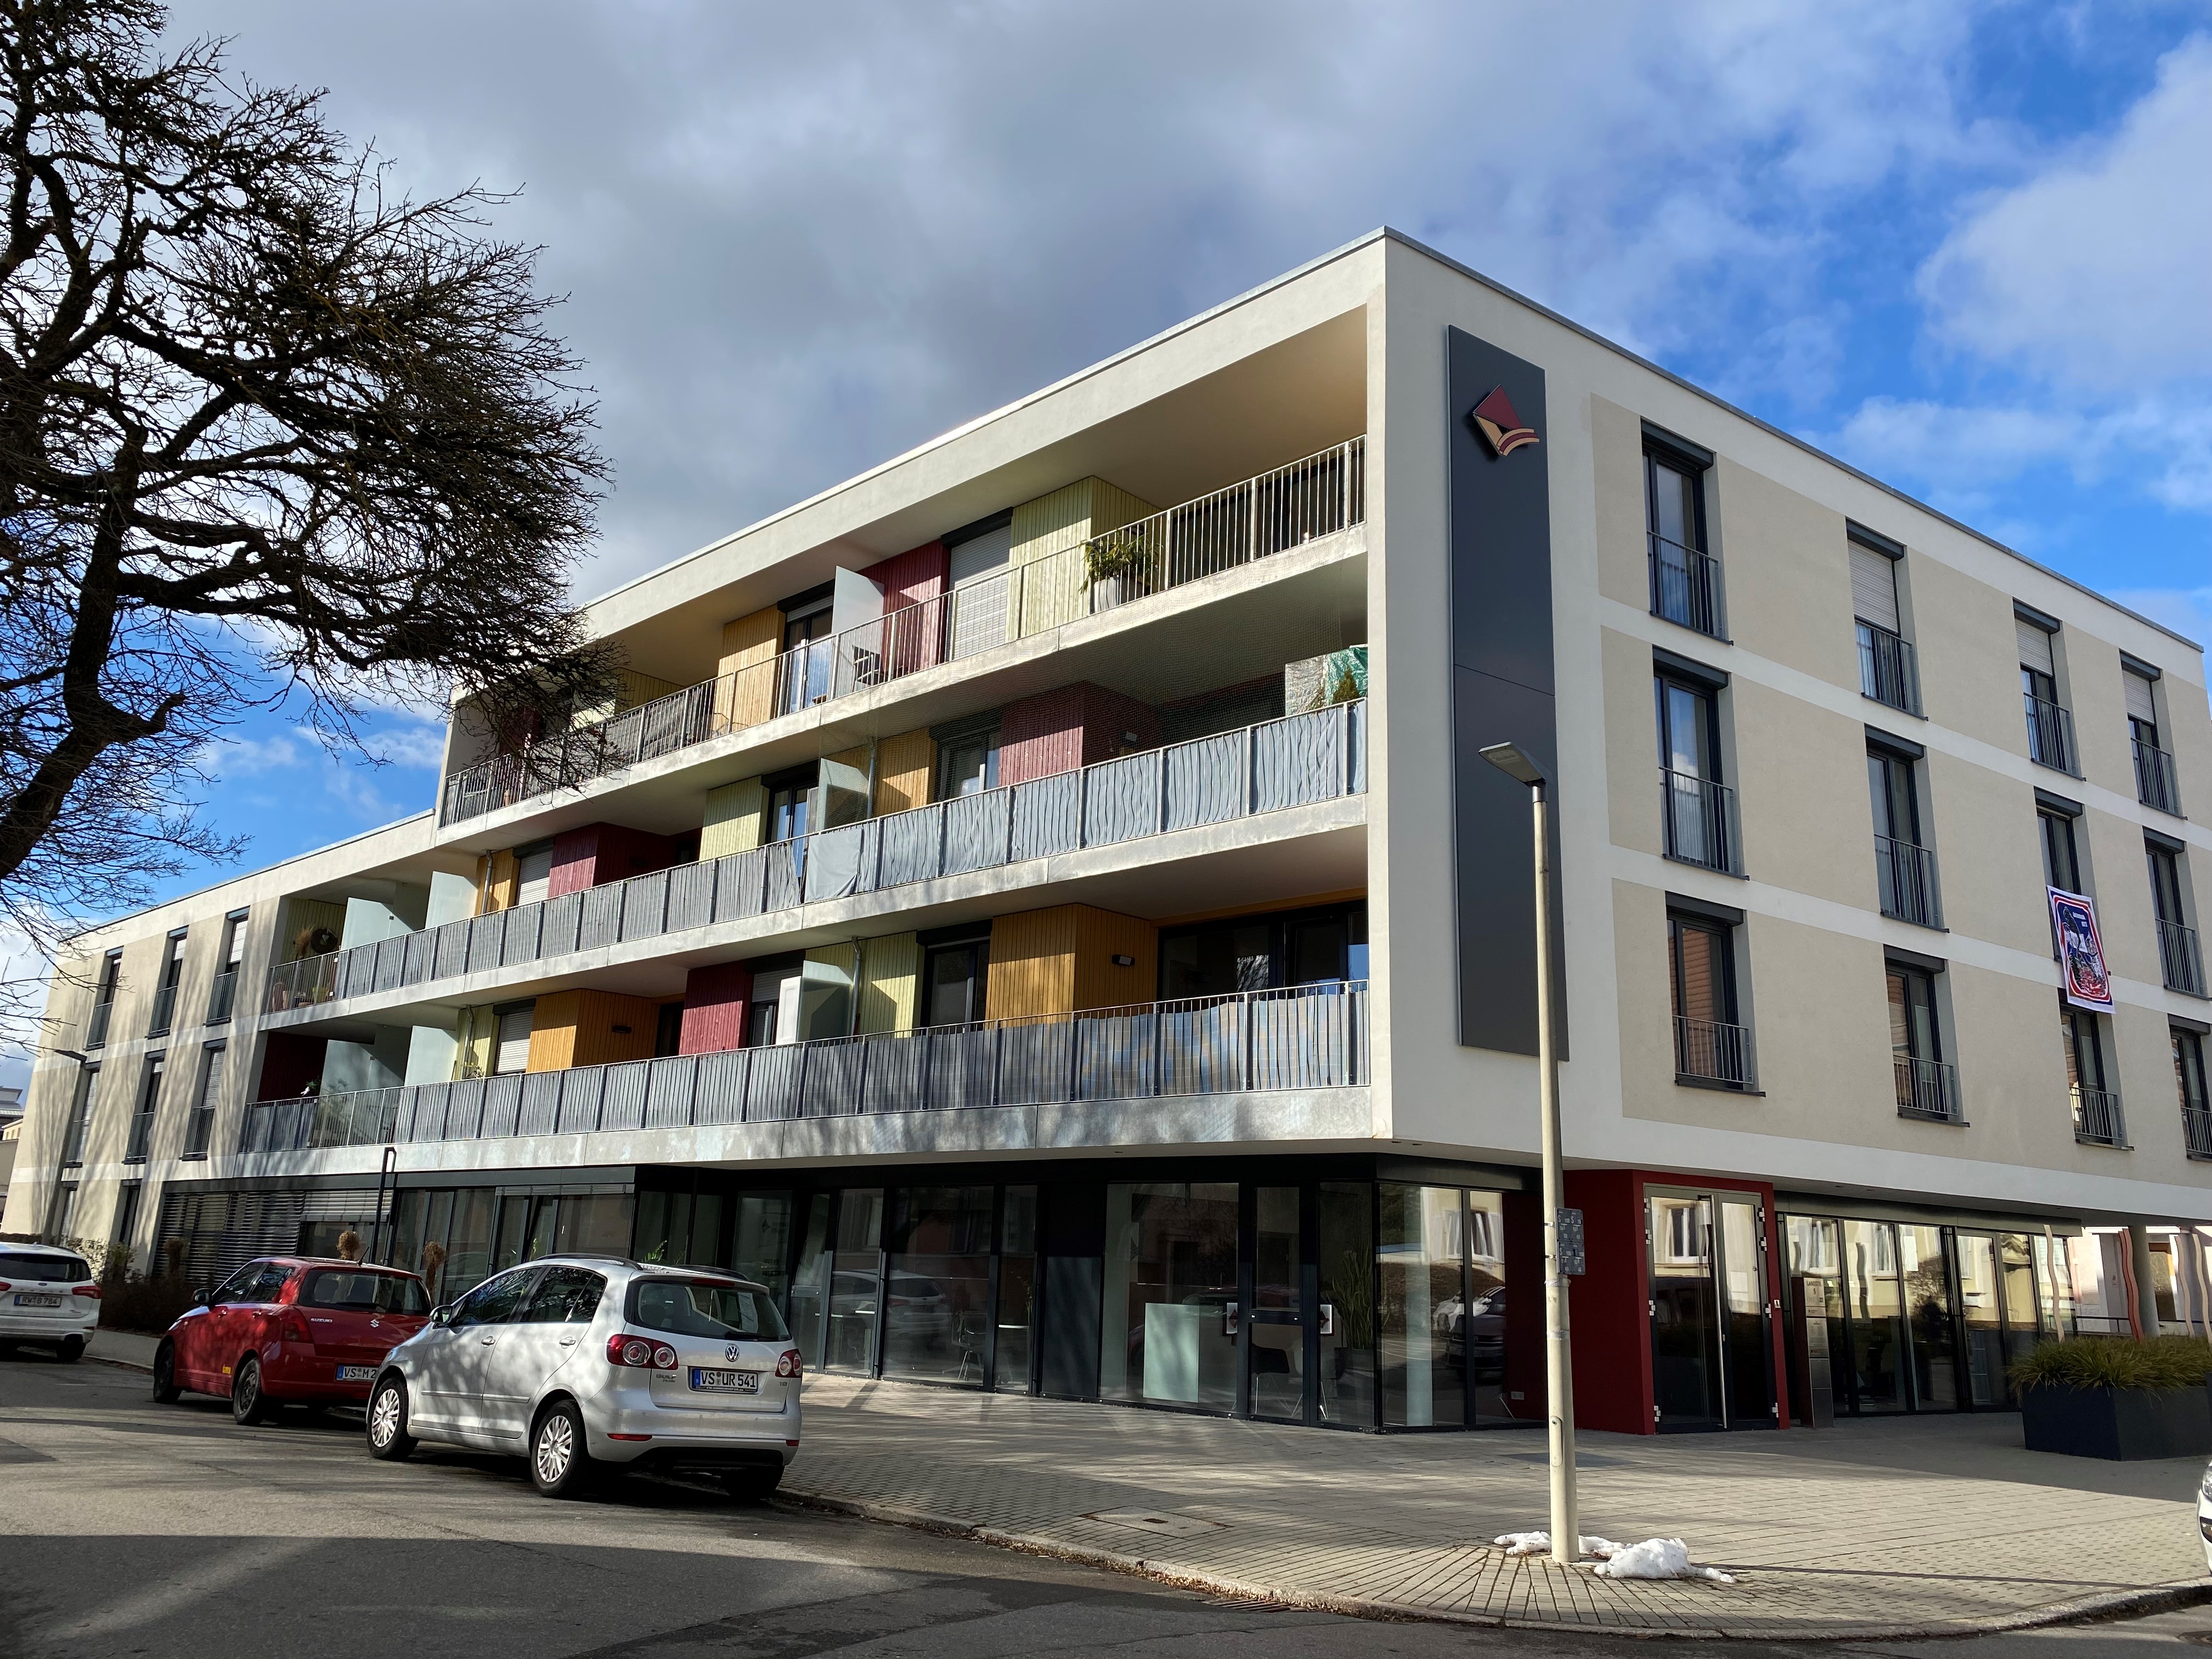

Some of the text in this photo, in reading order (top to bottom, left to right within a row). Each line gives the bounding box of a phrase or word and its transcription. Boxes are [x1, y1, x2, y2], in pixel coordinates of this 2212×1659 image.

[345, 1367, 357, 1378] VS
[362, 1368, 369, 1379] M
[701, 1372, 756, 1387] VS UR 541
